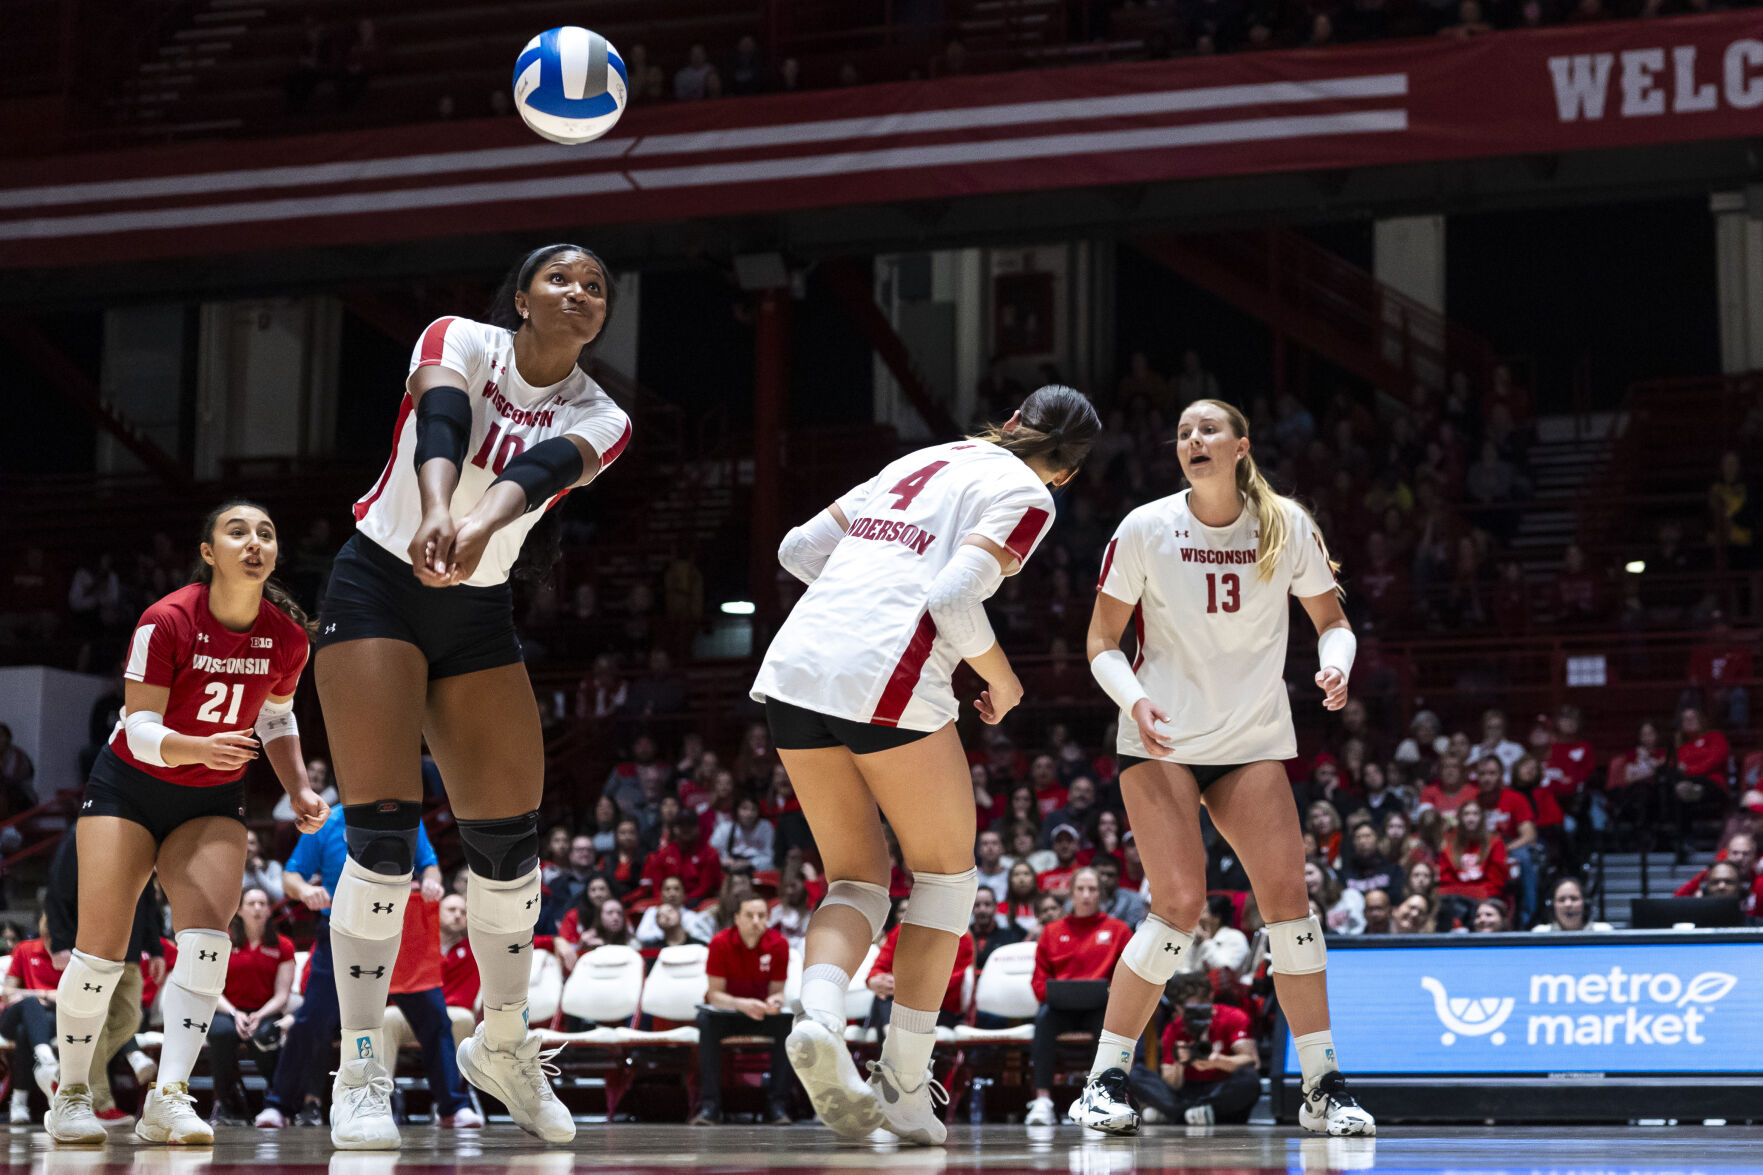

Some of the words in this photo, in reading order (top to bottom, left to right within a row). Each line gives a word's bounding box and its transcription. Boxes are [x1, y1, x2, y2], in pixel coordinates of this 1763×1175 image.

[471, 421, 525, 477] 10
[888, 460, 951, 511] 4
[1180, 547, 1257, 565] WISCONSIN
[1205, 572, 1241, 614] 13
[192, 653, 270, 675] WISCONSIN
[196, 681, 245, 725] 21
[1529, 965, 1681, 1004] metro
[1527, 1006, 1705, 1046] market
